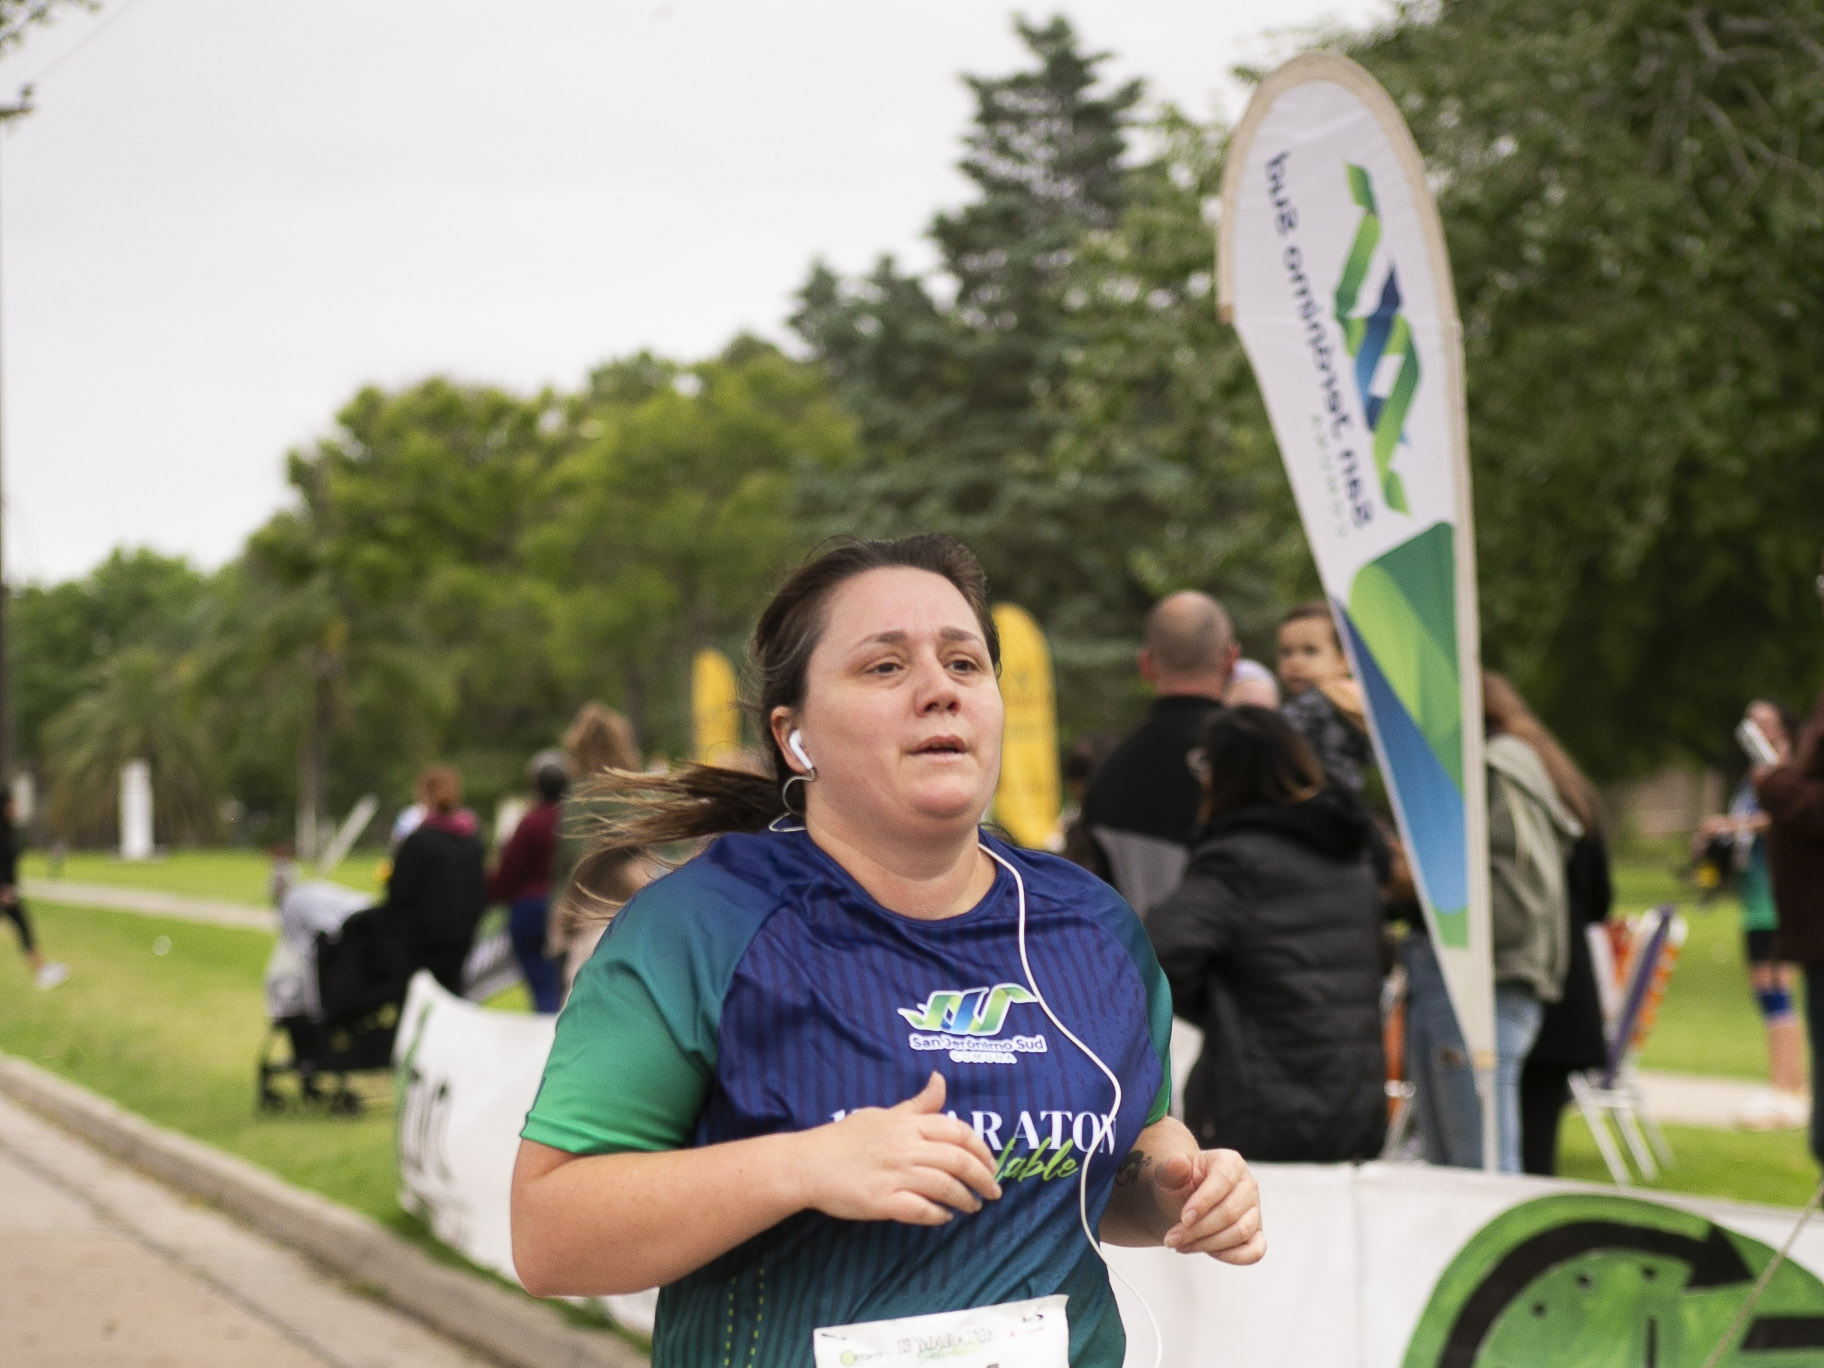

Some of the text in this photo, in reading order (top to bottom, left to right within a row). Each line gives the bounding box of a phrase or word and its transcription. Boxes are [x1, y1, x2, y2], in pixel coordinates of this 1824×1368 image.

[912, 1036, 941, 1049] San
[1015, 1038, 1044, 1050] Sud
[947, 1109, 1117, 1156] RATON
